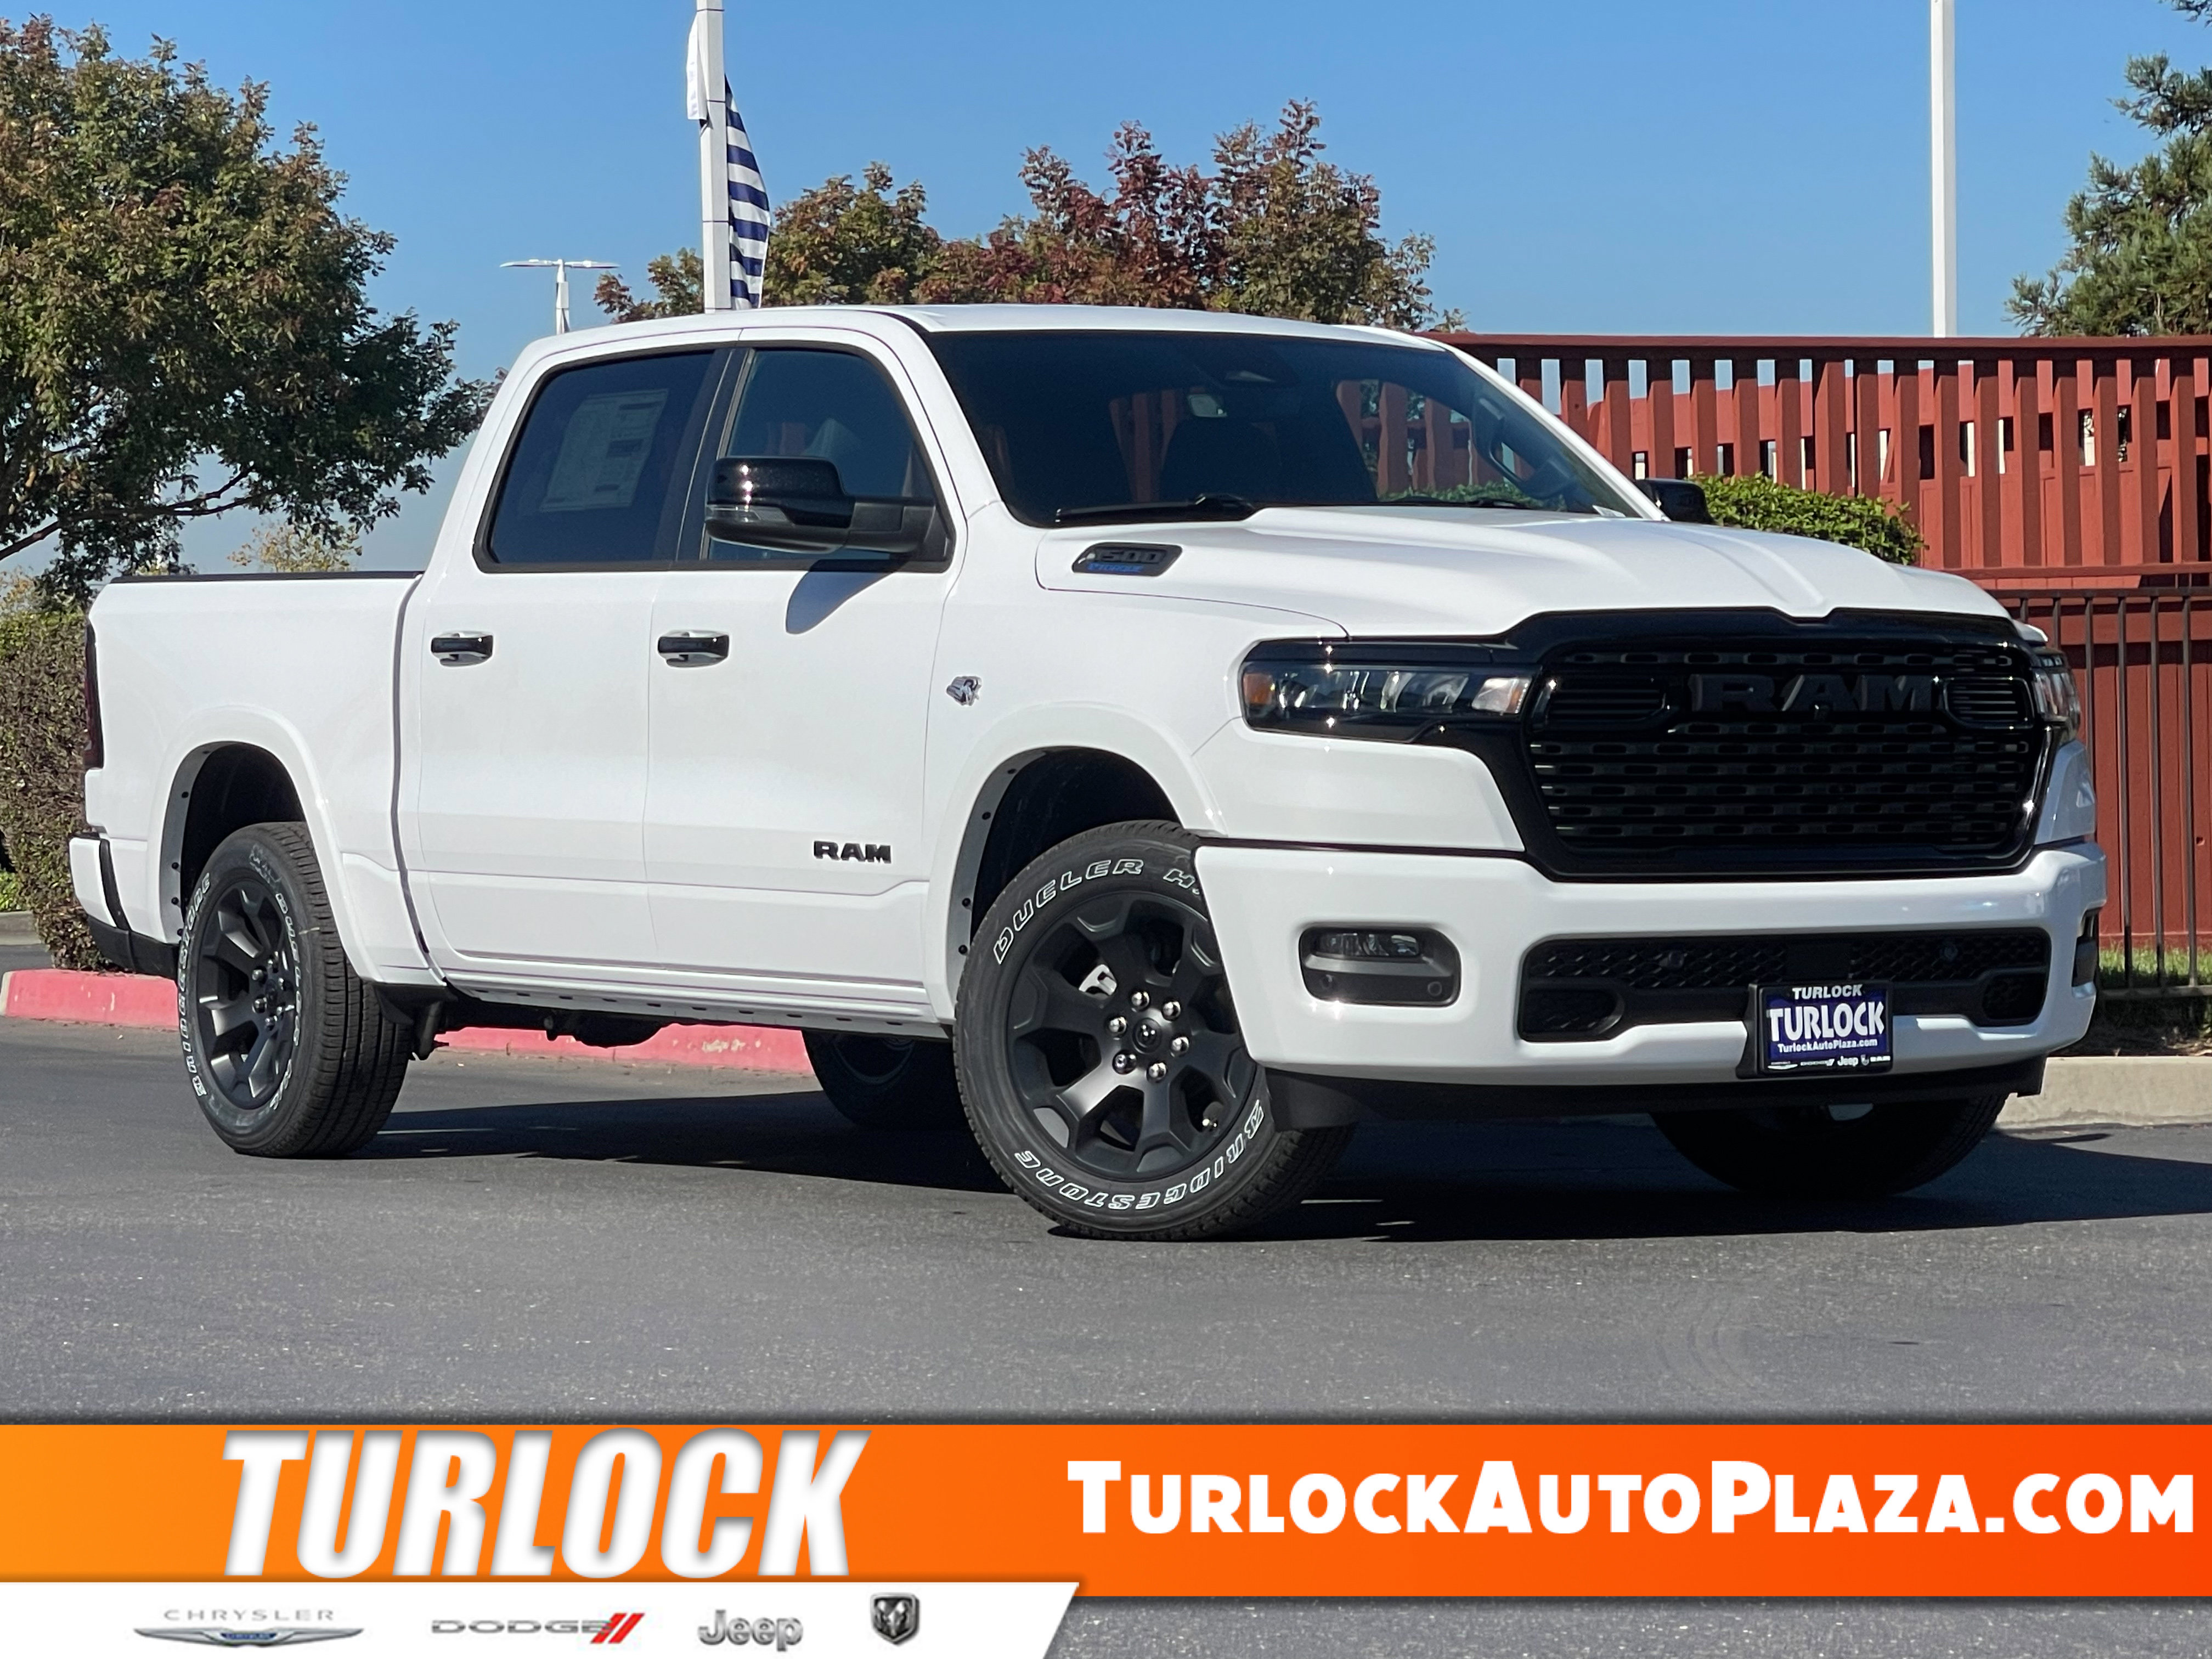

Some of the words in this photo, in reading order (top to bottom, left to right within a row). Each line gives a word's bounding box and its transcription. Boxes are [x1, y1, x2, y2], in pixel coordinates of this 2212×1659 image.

[1688, 674, 1933, 712] RAM
[814, 840, 891, 864] RAM
[993, 857, 1144, 966] DUELER
[1792, 984, 1863, 1000] TURLOCK
[1769, 1001, 1884, 1041] TURLOCK
[1777, 1039, 1878, 1053] TurlockAutoPlaza.com
[1837, 1056, 1859, 1067] Jeep
[1014, 1099, 1267, 1211] BRIDGESTONE
